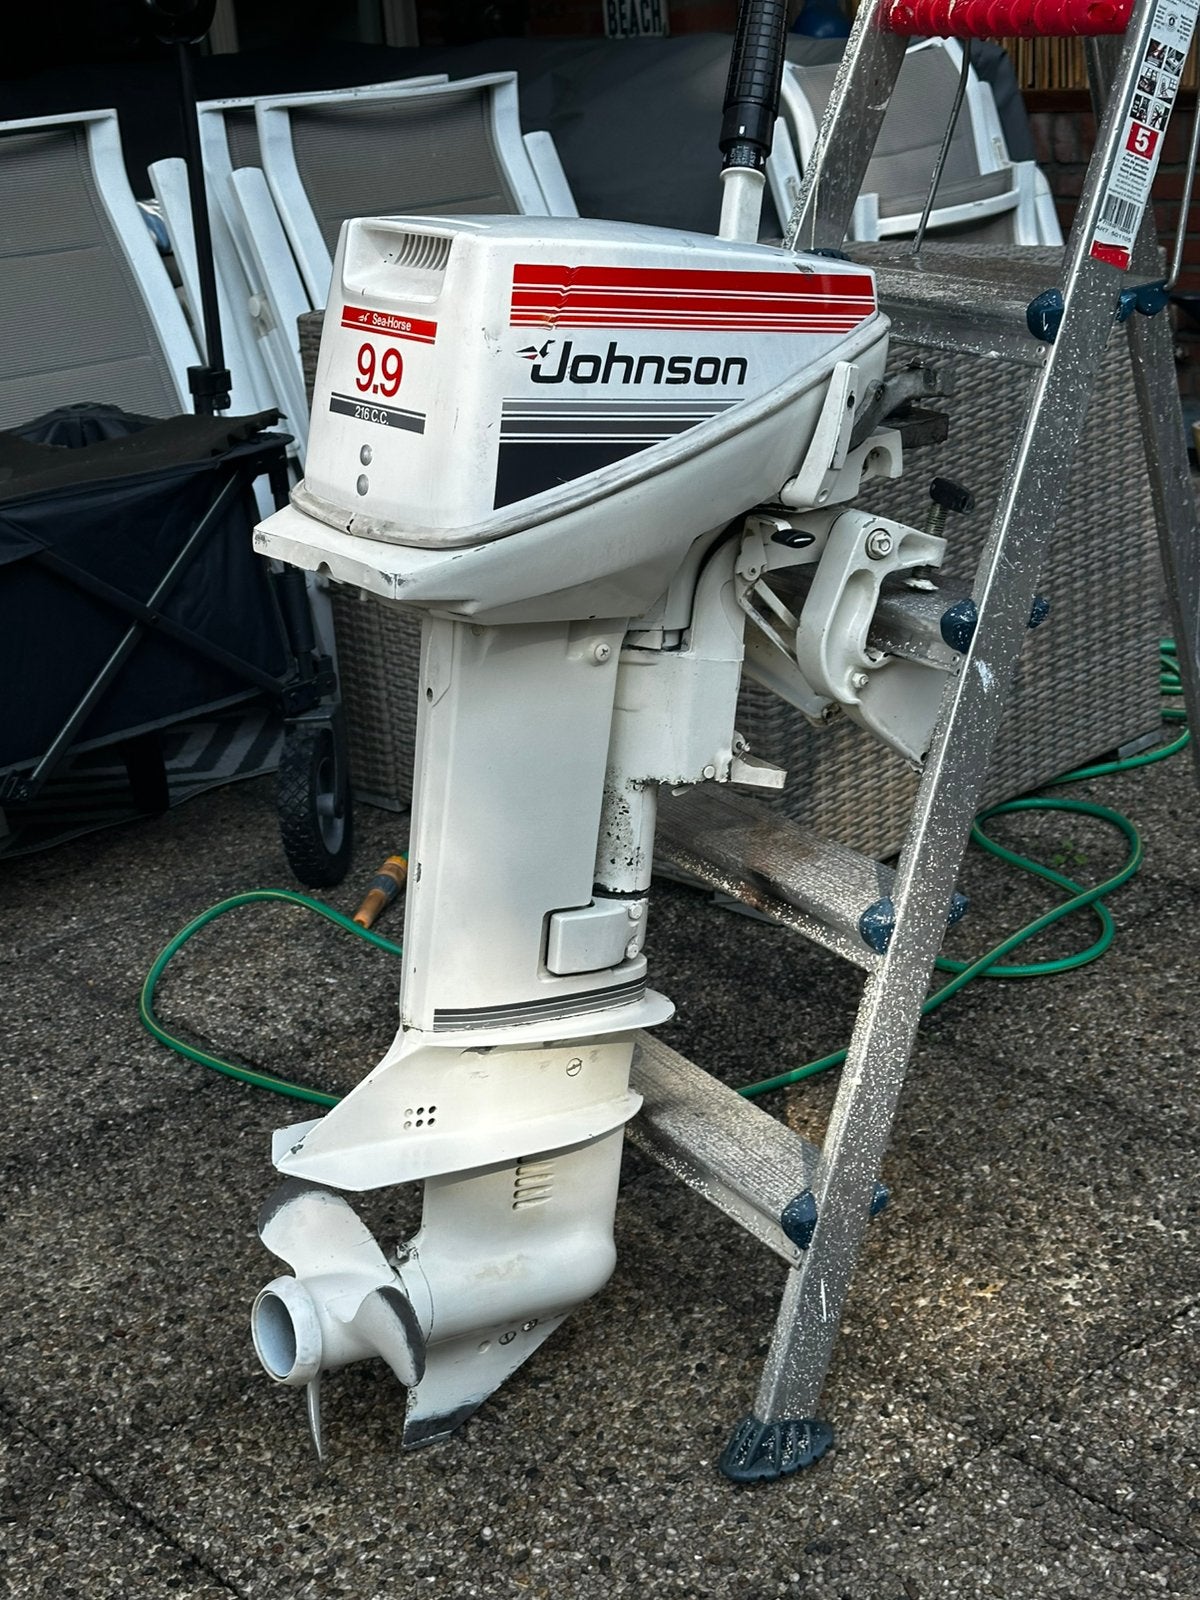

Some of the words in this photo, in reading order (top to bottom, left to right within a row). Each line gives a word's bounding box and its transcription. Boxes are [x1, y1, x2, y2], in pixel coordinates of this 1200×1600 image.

[1135, 128, 1149, 152] 5
[372, 313, 412, 331] Sea-Horse
[355, 342, 404, 398] 9.9
[530, 340, 748, 385] Johnson
[355, 405, 370, 420] 216
[371, 409, 389, 425] C.C.
